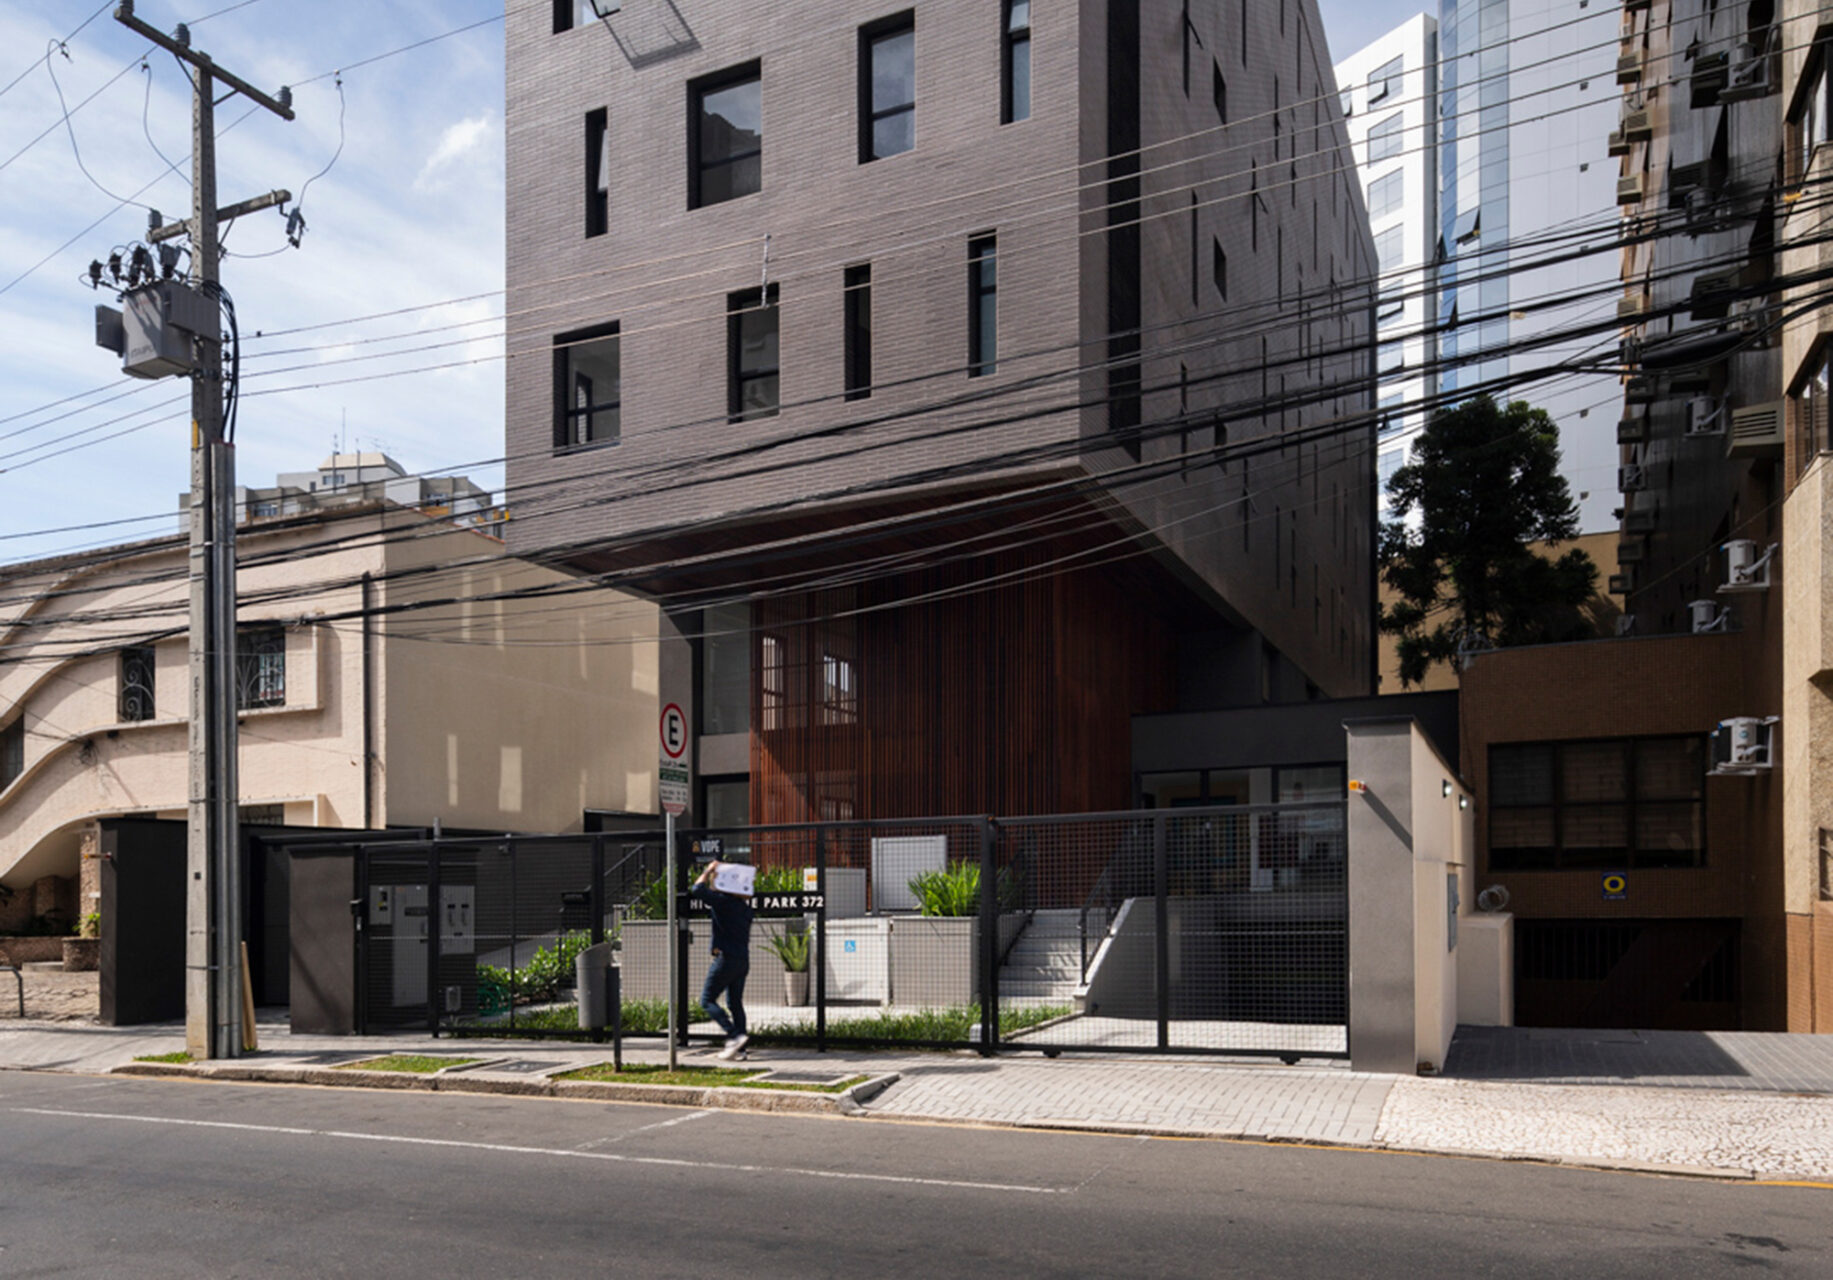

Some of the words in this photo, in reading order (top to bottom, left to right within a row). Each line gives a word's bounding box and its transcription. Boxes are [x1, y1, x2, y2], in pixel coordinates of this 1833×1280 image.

[669, 714, 679, 746] E
[763, 896, 798, 909] PARK
[801, 895, 825, 908] 372
